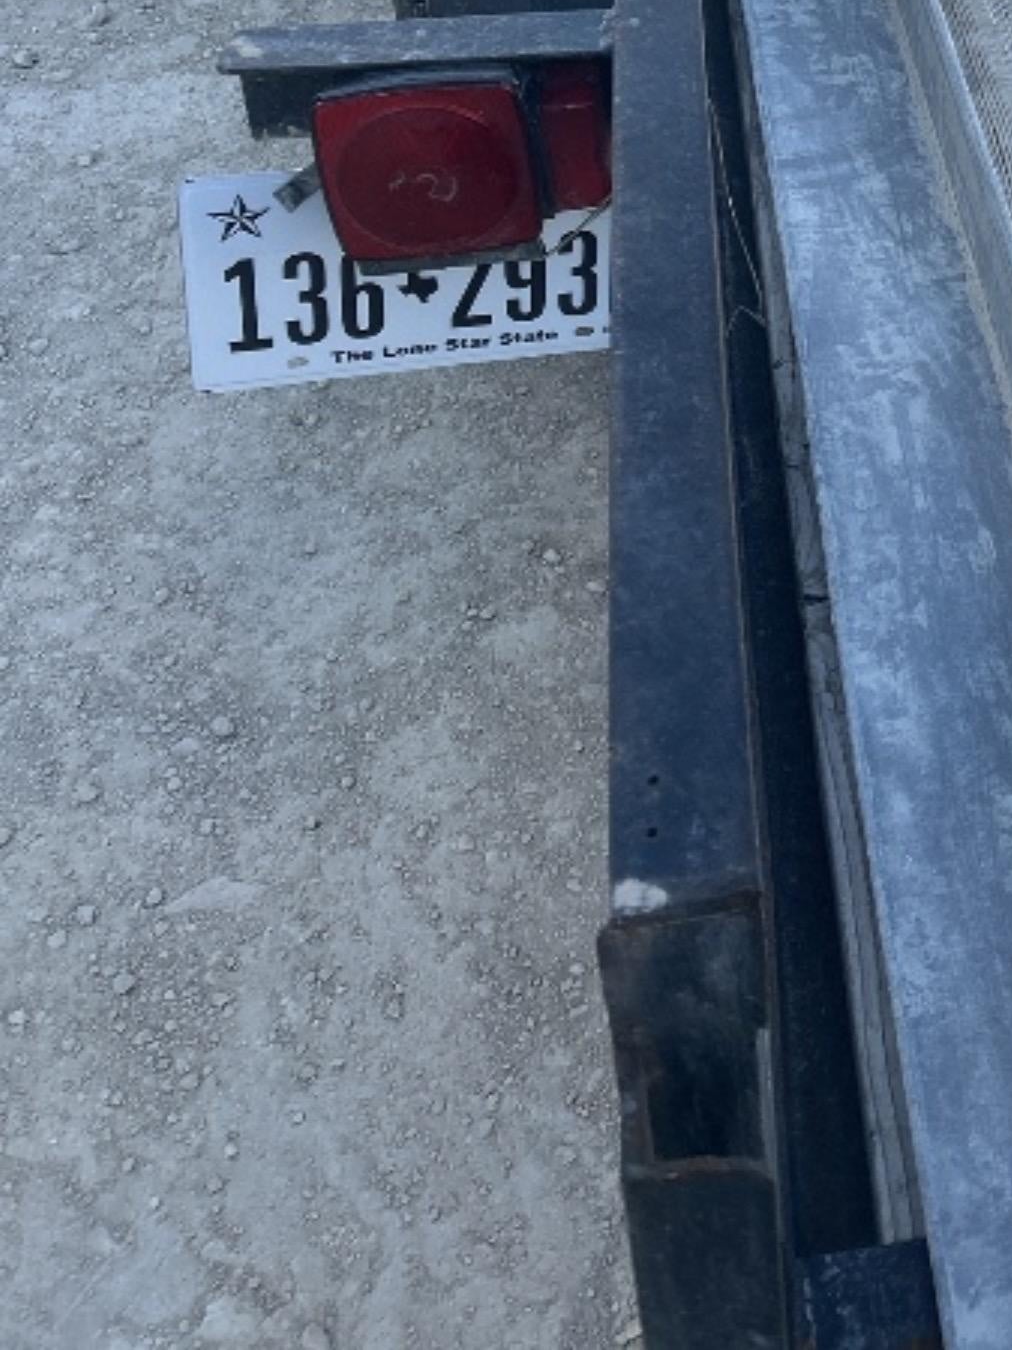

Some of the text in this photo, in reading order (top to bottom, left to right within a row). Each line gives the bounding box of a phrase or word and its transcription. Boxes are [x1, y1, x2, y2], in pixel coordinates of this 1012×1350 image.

[333, 349, 373, 364] The
[446, 336, 491, 351] Star
[499, 329, 560, 347] State
